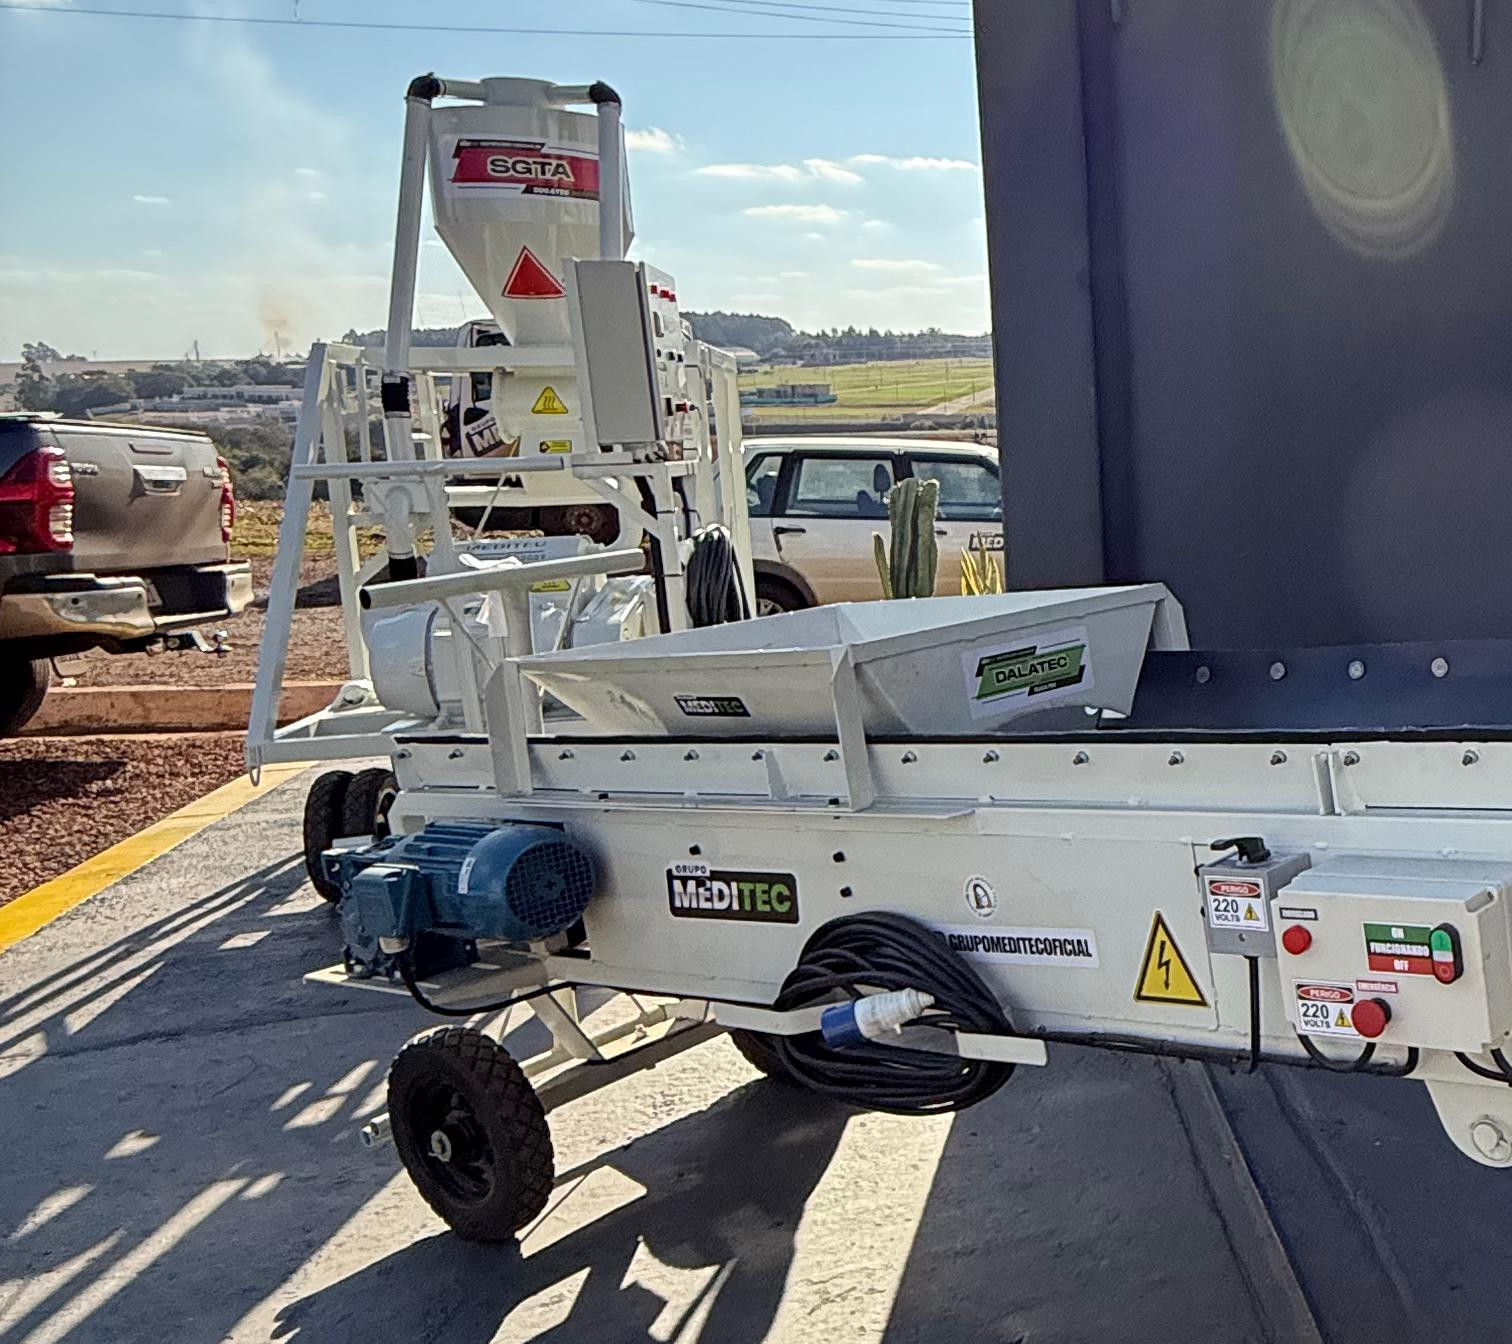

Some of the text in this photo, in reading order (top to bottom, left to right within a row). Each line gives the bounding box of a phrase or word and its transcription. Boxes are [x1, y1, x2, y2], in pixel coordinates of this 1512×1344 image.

[489, 158, 572, 180] SGTA
[995, 656, 1068, 684] DALATEC
[680, 700, 745, 713] MEDITEC
[675, 865, 707, 874] GRUPO
[672, 879, 792, 913] MEDITEC
[1213, 898, 1239, 913] 220
[1215, 913, 1241, 922] VOLTS
[948, 934, 1093, 958] GRUPOMEDITECOFICIAL
[1310, 989, 1341, 999] PERIGO
[1301, 1003, 1329, 1019] 220
[1303, 1019, 1331, 1028] VOLTS
